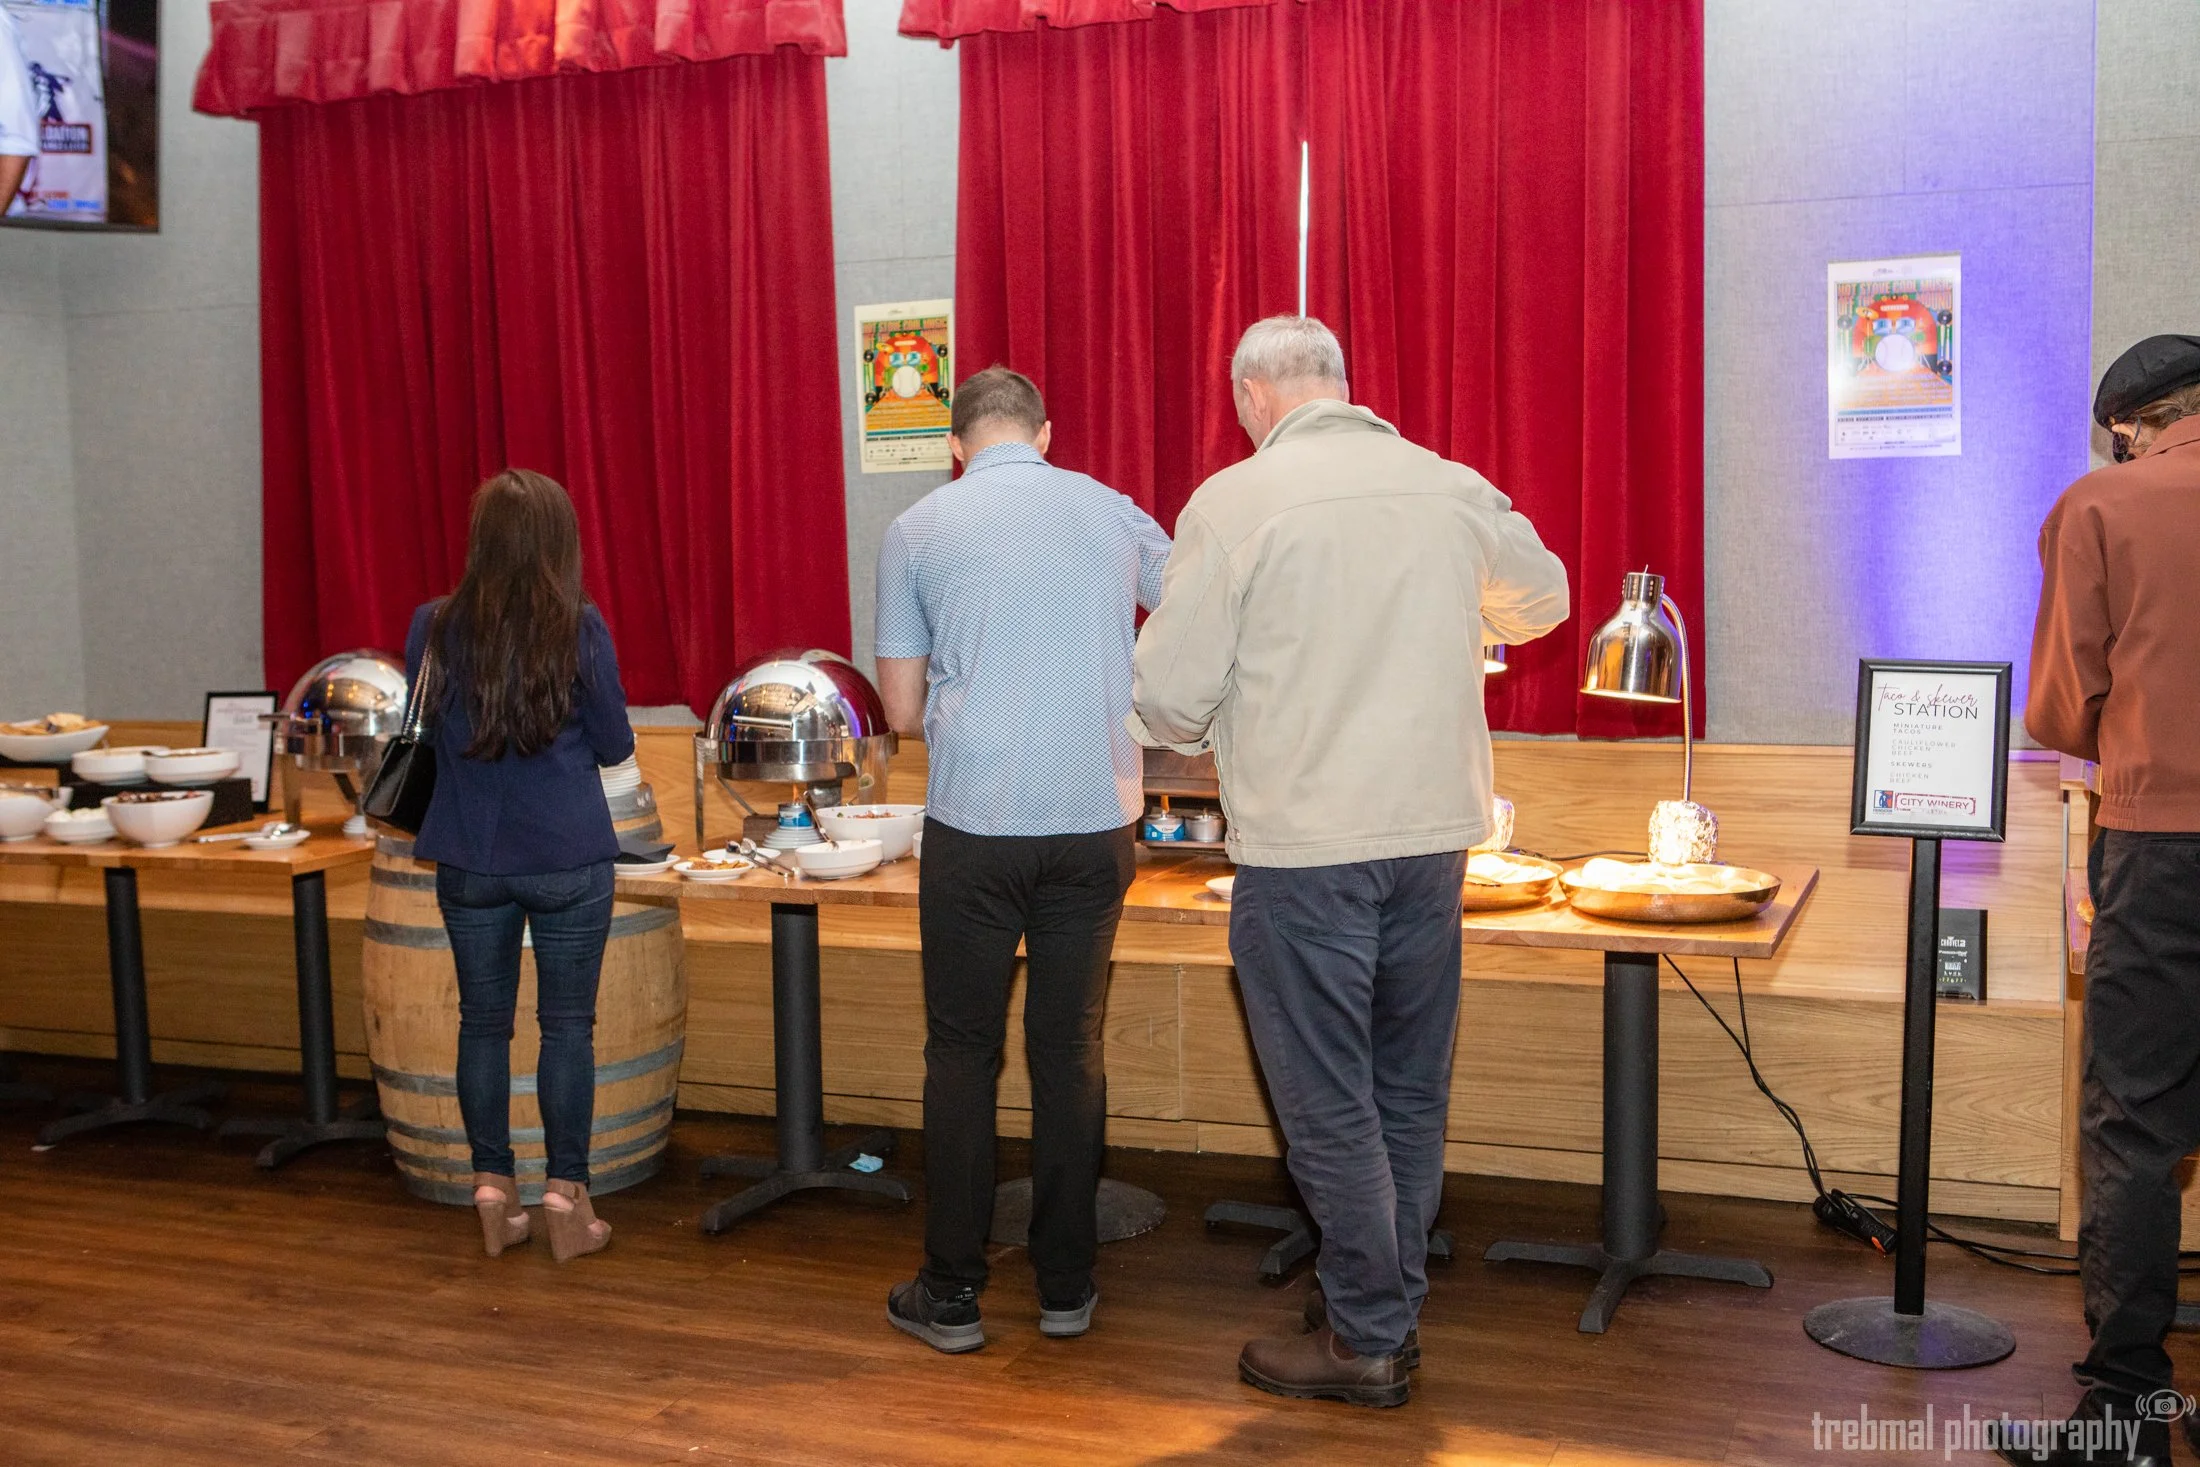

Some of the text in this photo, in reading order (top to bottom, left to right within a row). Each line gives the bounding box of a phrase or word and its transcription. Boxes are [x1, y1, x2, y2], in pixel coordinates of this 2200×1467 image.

[1911, 690, 1921, 702] &
[1927, 683, 1978, 708] skewer
[1894, 702, 1978, 719] STATION
[1892, 740, 1956, 748] CAULIFLOWER
[1900, 798, 1970, 809] CITY WINERY
